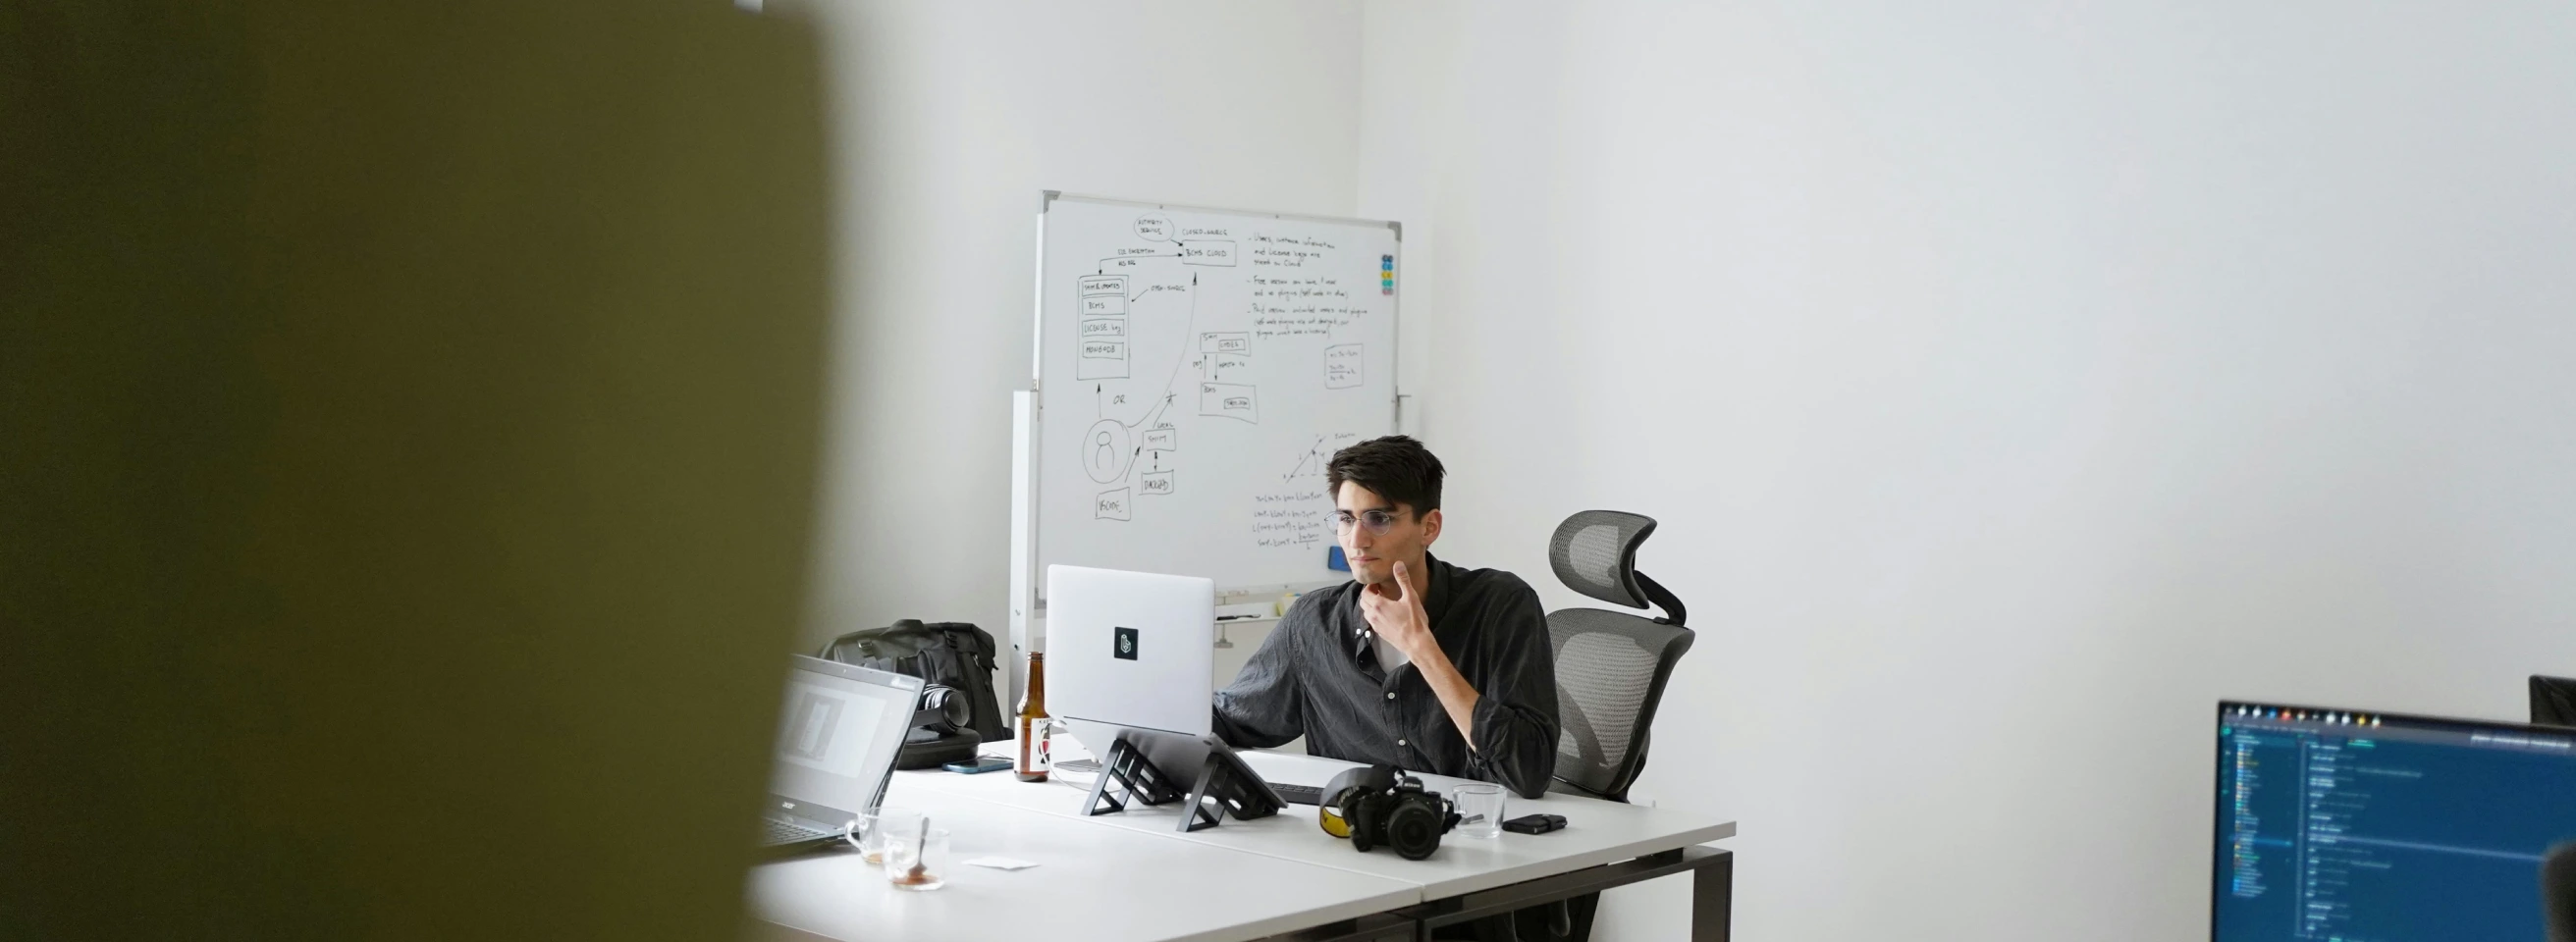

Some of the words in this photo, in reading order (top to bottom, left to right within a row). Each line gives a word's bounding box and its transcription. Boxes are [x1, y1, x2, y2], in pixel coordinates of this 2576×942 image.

[1185, 248, 1204, 257] BCMS
[1088, 301, 1105, 310] BCMS
[1084, 323, 1108, 334] LICENSE
[1086, 344, 1116, 354] MONGODB
[1112, 393, 1126, 405] OR
